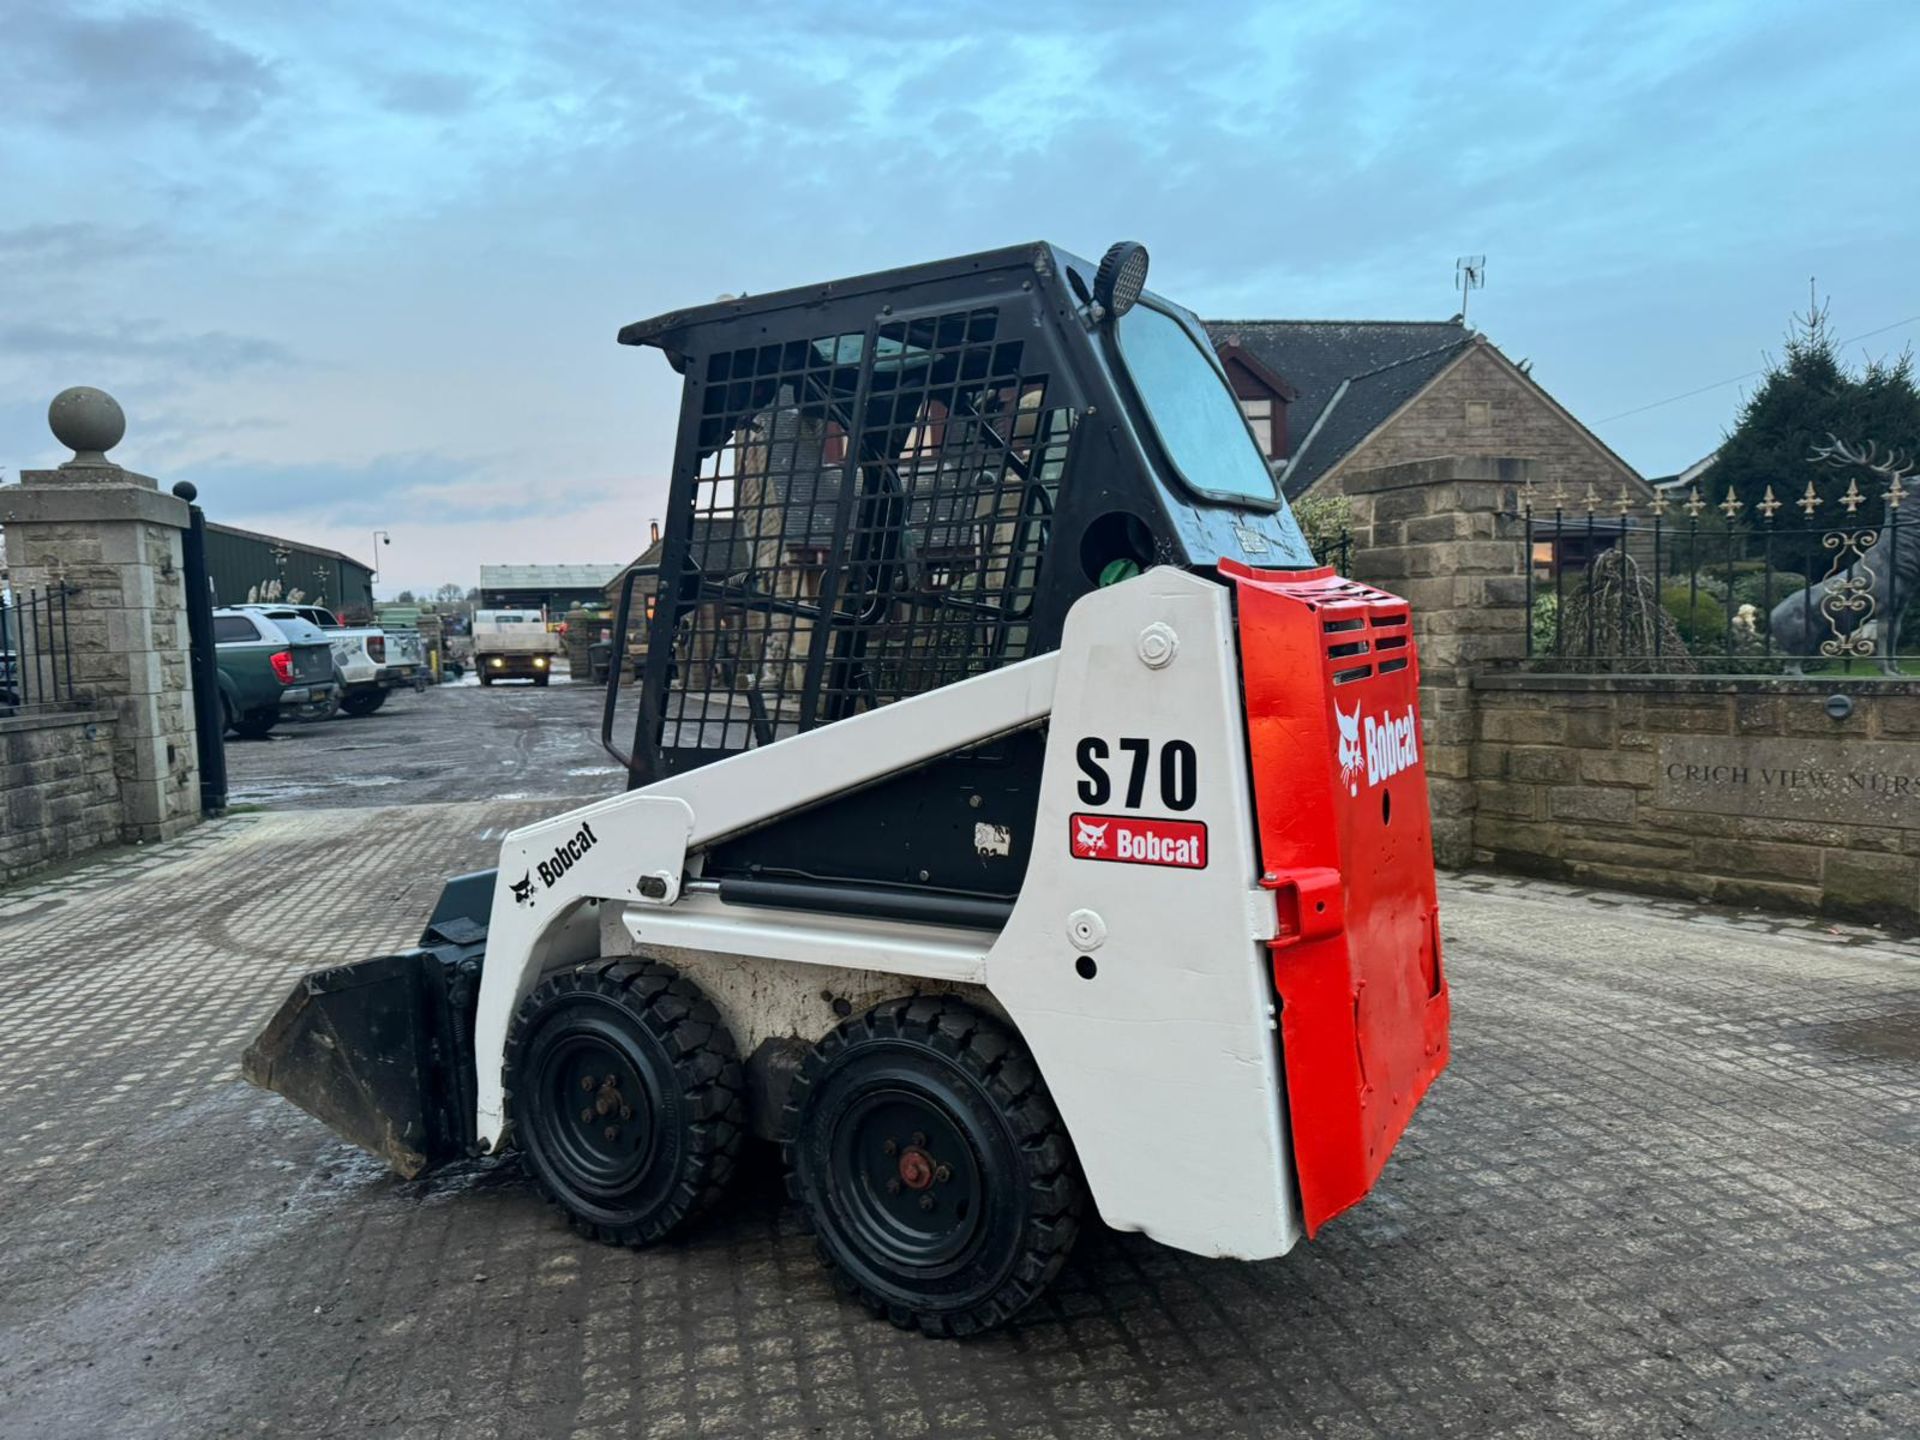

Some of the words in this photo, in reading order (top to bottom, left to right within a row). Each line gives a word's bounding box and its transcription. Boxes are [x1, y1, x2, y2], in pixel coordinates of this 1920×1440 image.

[1076, 736, 1197, 812] S70
[1364, 704, 1418, 787] Bobcat
[1667, 763, 1749, 784] CRICH
[1761, 768, 1832, 789] VIEW
[536, 821, 597, 888] Bobcat
[1116, 828, 1199, 864] Bobcat
